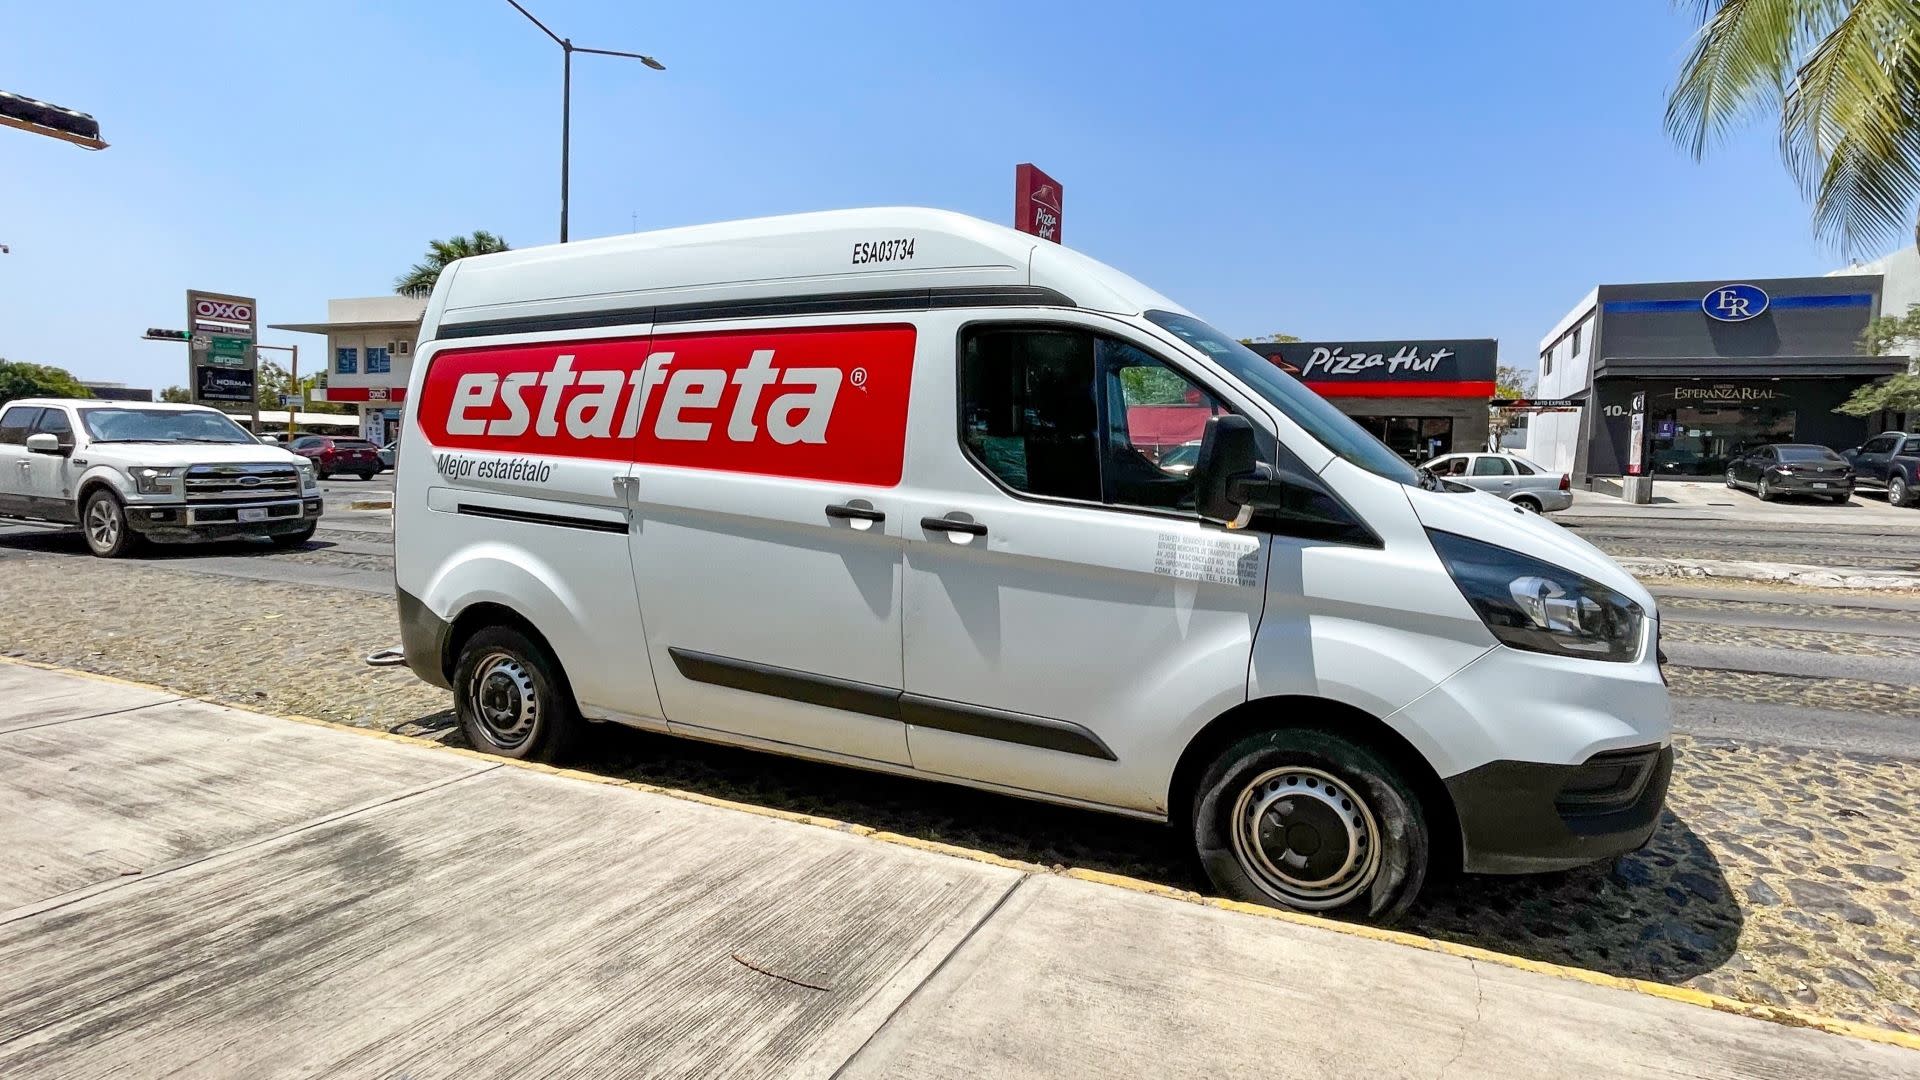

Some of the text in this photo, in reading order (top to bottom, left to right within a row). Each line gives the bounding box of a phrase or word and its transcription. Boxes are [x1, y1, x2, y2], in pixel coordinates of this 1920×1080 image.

[1036, 208, 1056, 226] Pizza
[1039, 225, 1055, 240] Hut
[852, 238, 914, 264] ESA03734
[197, 301, 251, 320] OXXO
[1303, 346, 1454, 376] Pizza Hut
[446, 349, 842, 445] estafeta
[1742, 387, 1776, 400] REAL
[437, 453, 550, 482] Mejor estafétalo
